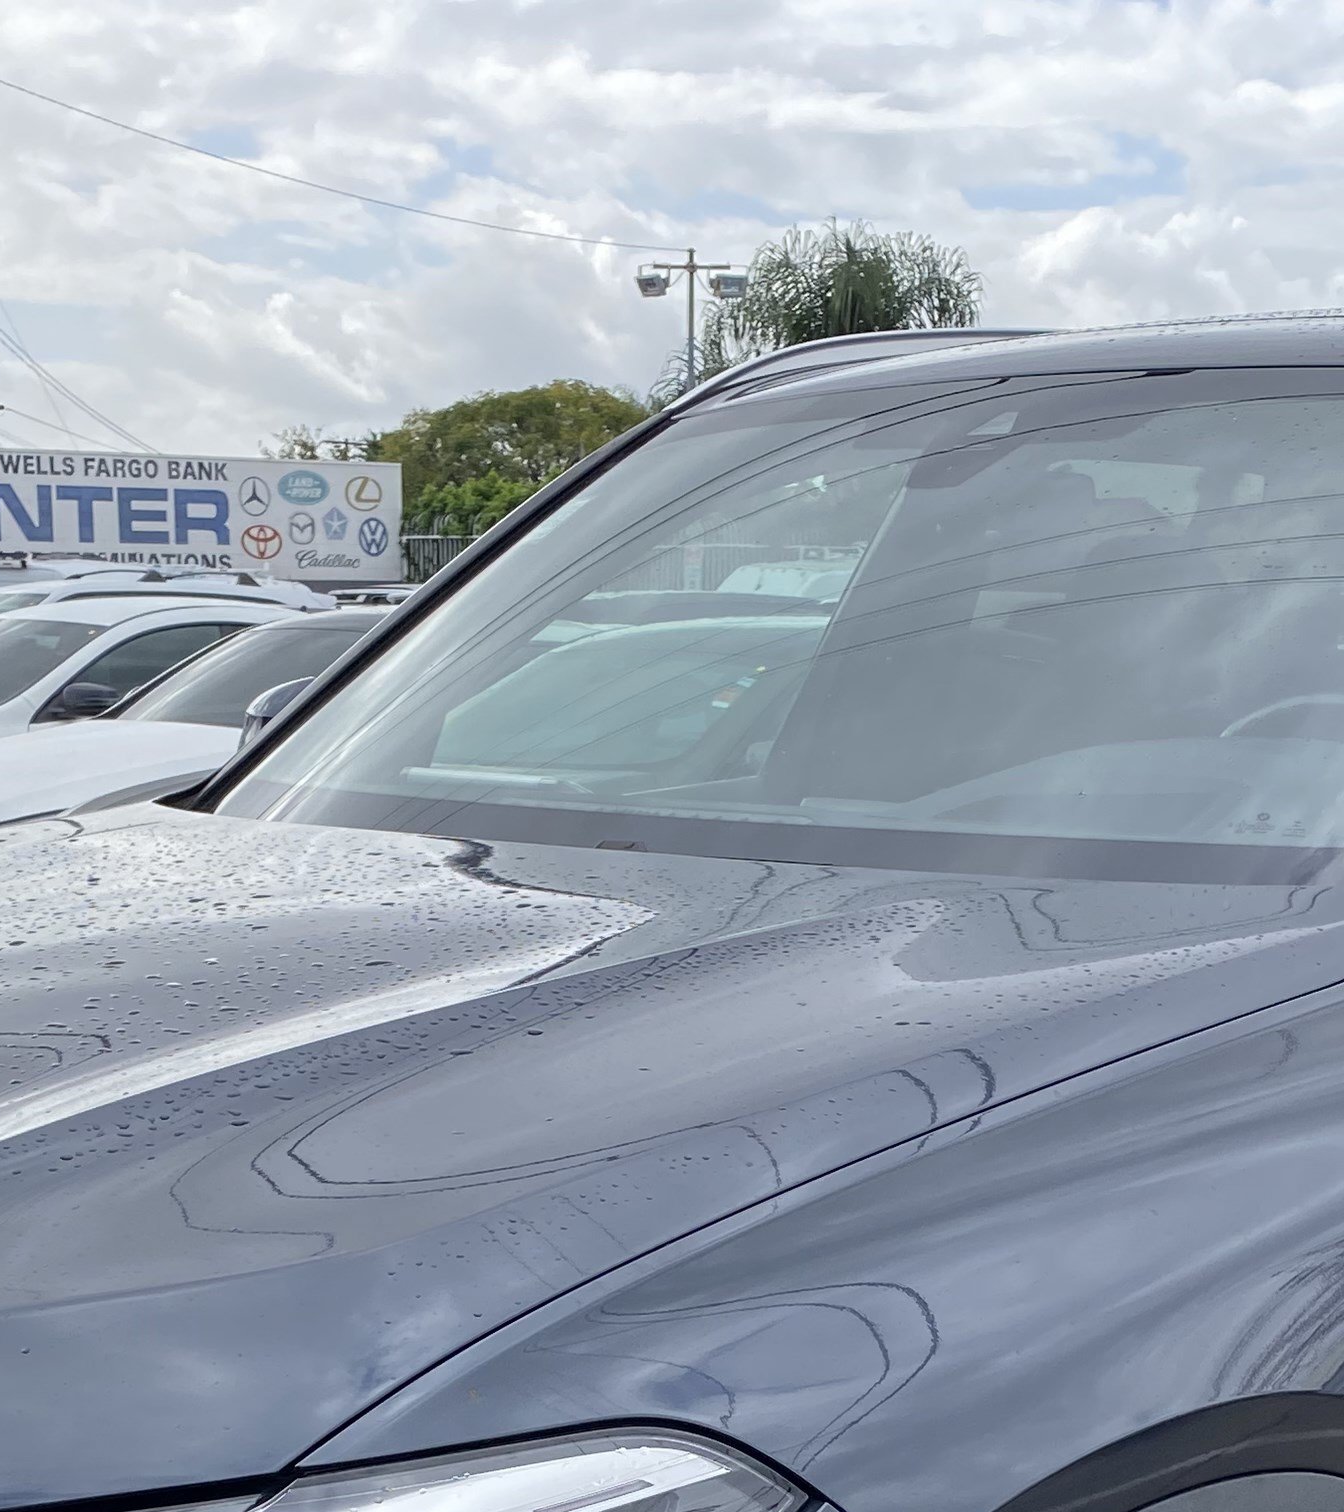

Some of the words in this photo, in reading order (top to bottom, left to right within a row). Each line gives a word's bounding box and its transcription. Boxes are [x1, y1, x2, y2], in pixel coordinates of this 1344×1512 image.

[83, 457, 158, 479] FARGO
[168, 461, 228, 481] BANK
[295, 549, 360, 569] Cadillac
